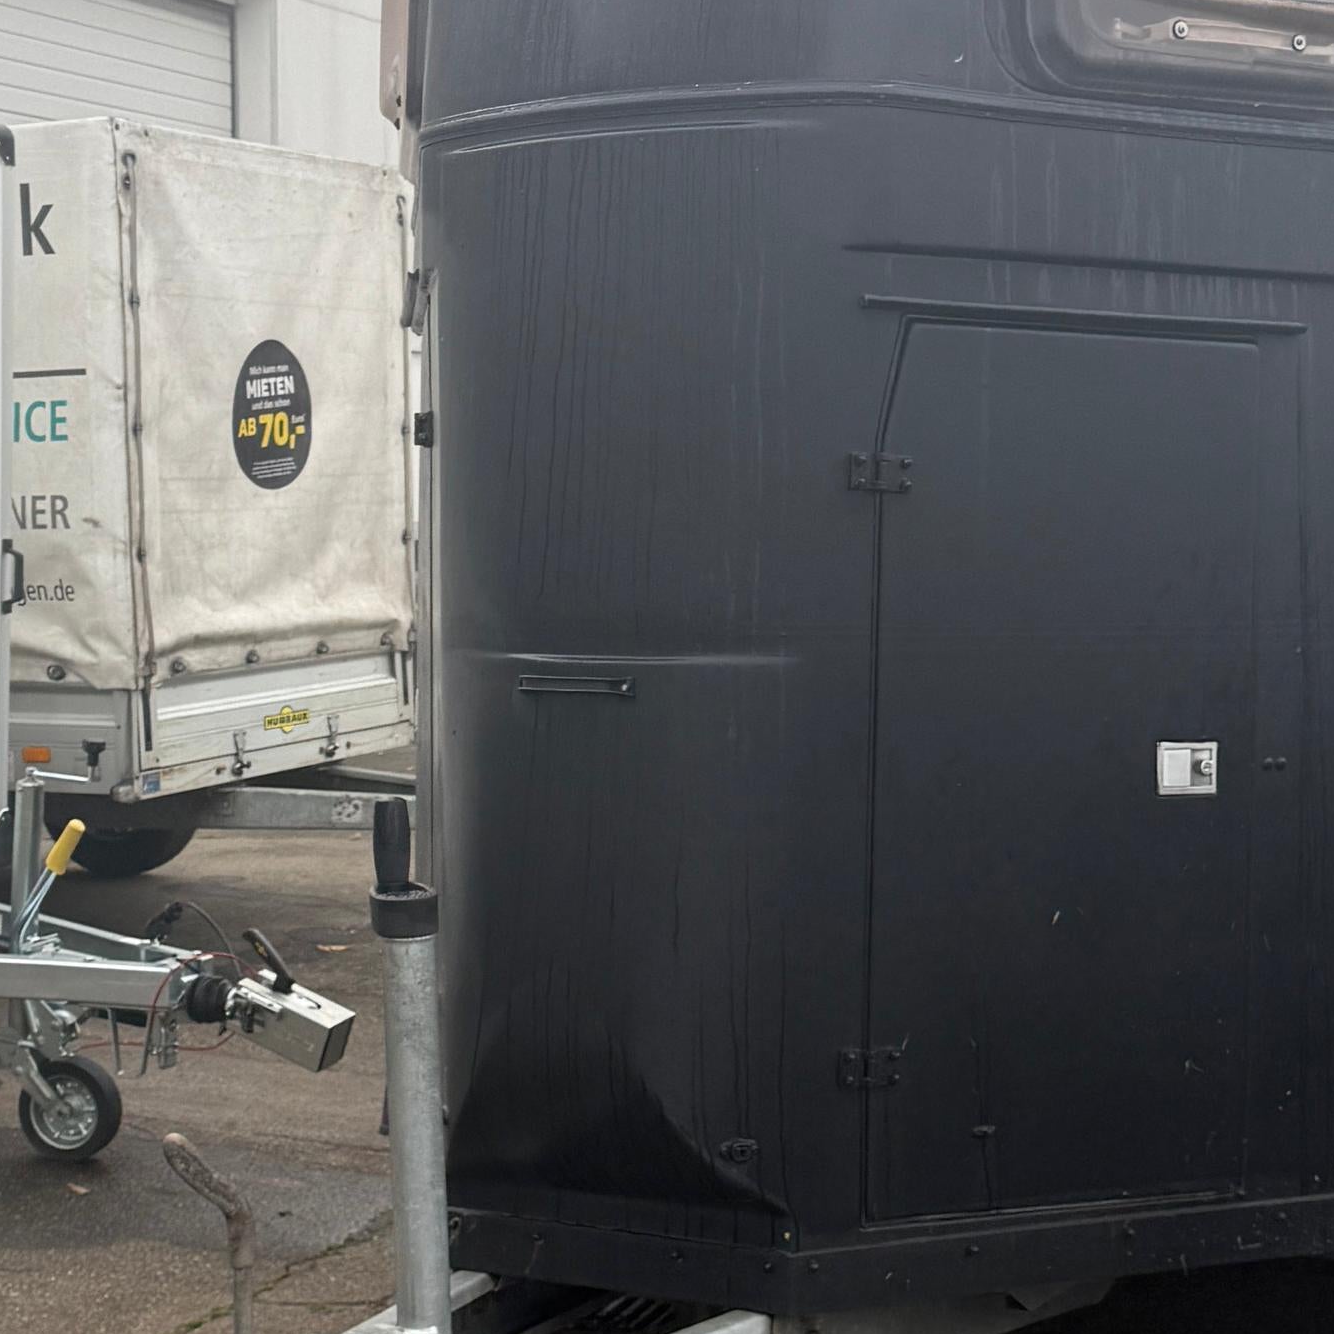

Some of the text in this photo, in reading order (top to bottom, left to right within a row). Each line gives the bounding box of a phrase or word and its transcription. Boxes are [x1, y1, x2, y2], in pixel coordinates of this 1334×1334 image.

[19, 183, 56, 256] k
[246, 375, 295, 399] MIETEN
[13, 400, 69, 443] ICE
[238, 417, 257, 438] AB
